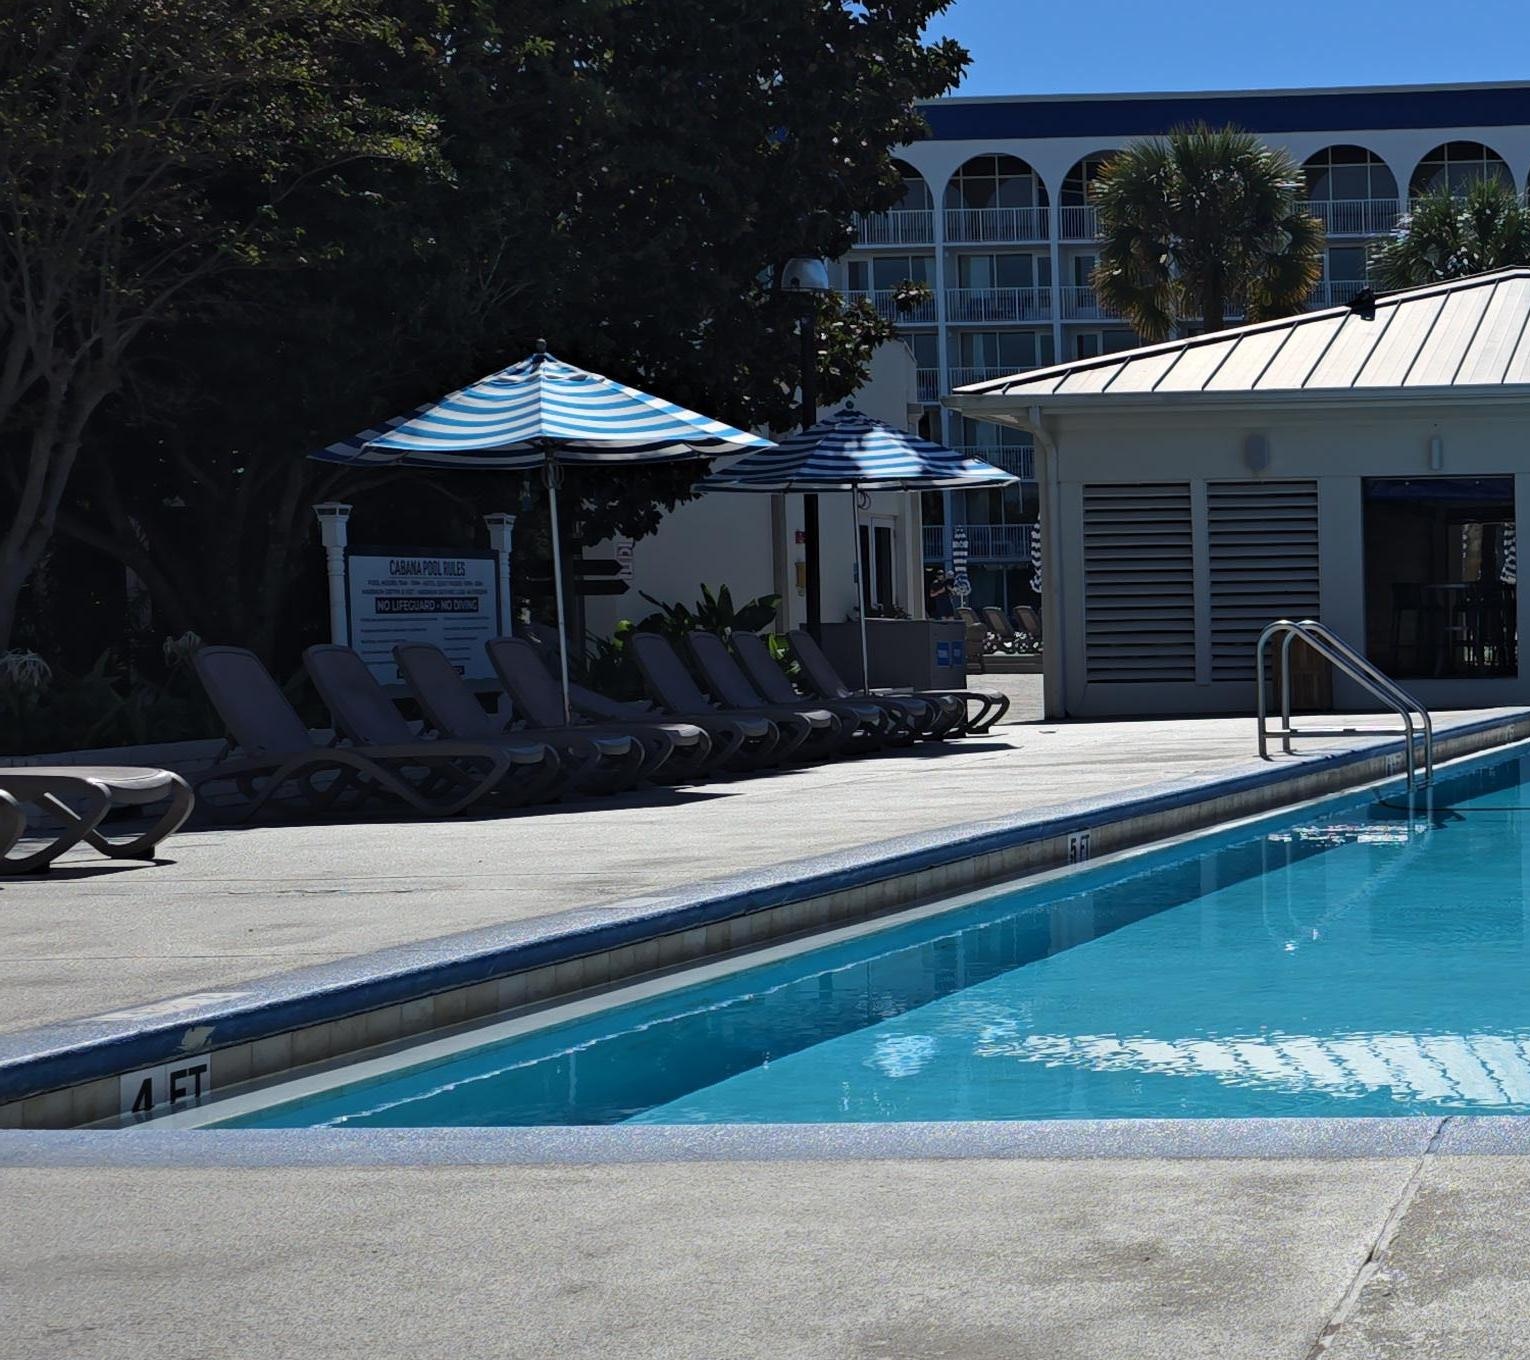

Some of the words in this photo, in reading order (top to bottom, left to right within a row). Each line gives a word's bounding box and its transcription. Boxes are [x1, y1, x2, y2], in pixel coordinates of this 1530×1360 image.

[389, 559, 422, 576] CABANA
[423, 559, 442, 576] POOL
[443, 560, 465, 576] RULES
[377, 599, 390, 611] NO
[392, 599, 435, 611] LIFEGUARD
[441, 599, 452, 610] NO
[453, 599, 477, 610] DIVING
[1070, 837, 1077, 864] 5
[132, 1077, 154, 1113] 4
[169, 1063, 207, 1104] FT
